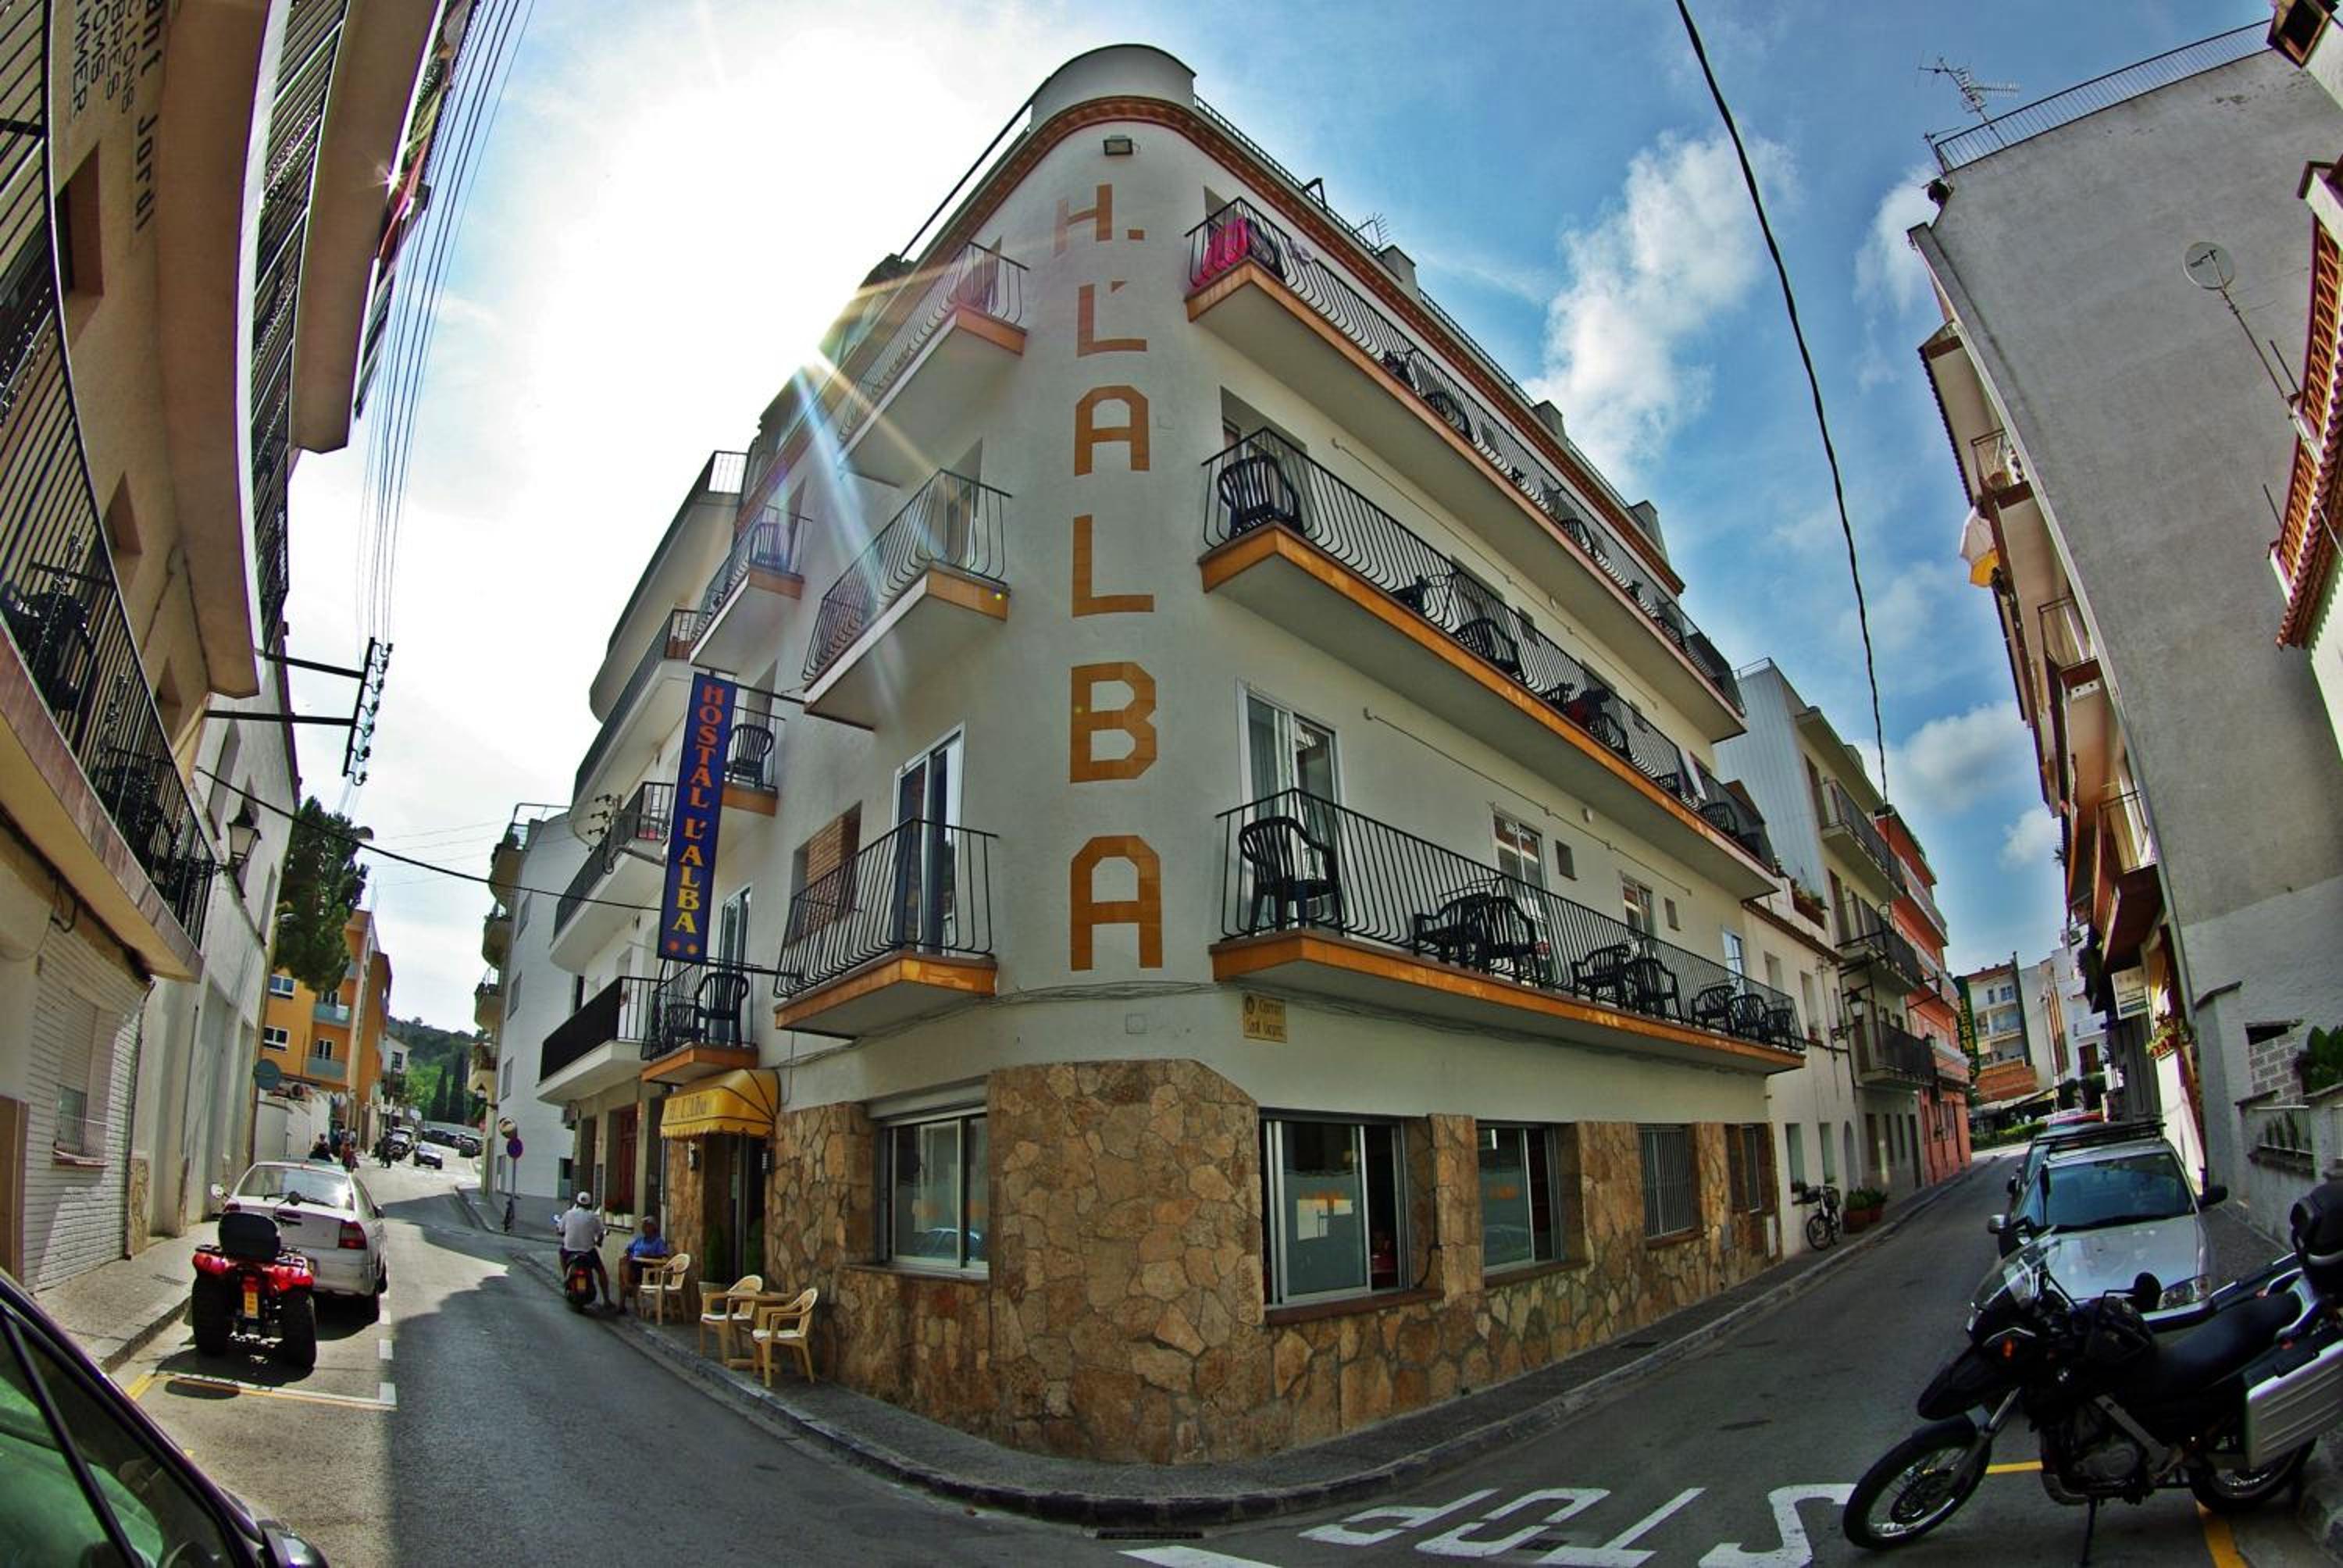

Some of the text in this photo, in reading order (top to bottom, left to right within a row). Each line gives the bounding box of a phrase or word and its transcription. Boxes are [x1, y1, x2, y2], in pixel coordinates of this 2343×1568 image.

[91, 0, 109, 84] OMS
[106, 0, 126, 101] BRES
[1068, 280, 1164, 971] L'ALBA
[672, 684, 726, 934] HOSTAL L'ALBA
